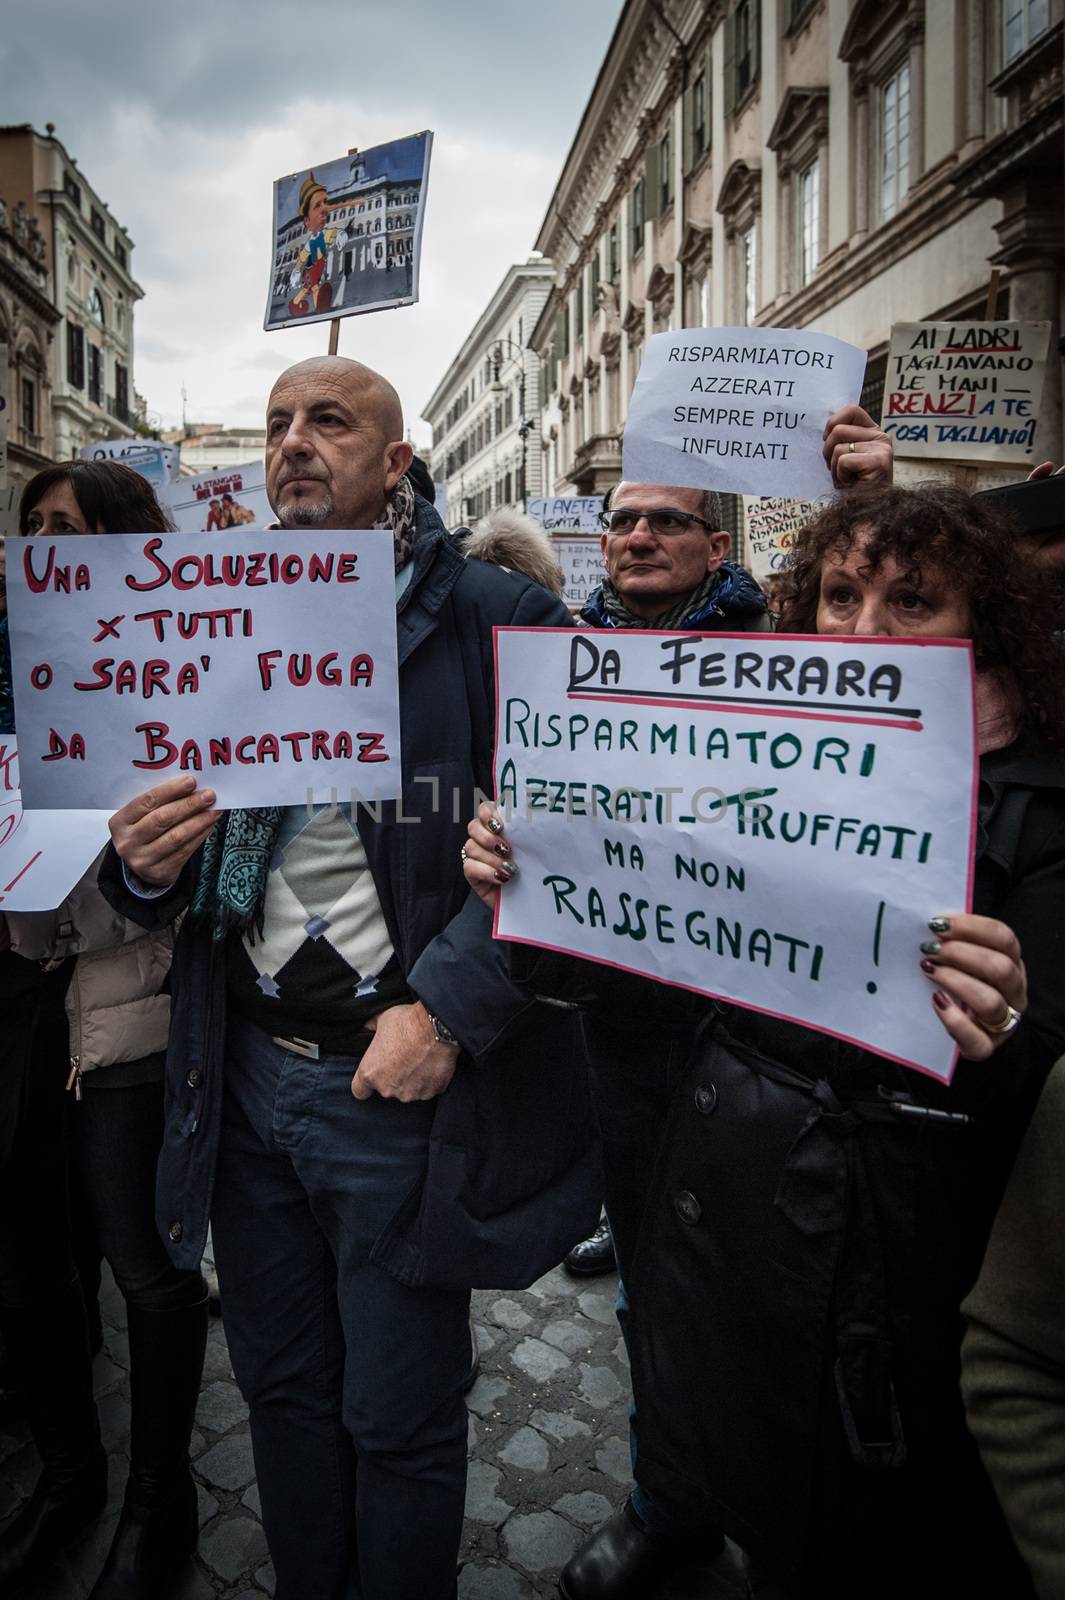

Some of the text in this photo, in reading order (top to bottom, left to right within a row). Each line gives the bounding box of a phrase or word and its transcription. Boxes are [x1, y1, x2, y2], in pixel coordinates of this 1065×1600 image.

[910, 327, 1021, 350] AI LADRI
[668, 346, 835, 370] RISPARMIATORI
[893, 354, 1034, 374] TAGLIAVANO
[690, 377, 795, 397] AZZERATI
[897, 374, 926, 391] LE
[938, 374, 997, 393] MANI
[673, 406, 755, 427] SEMPRE
[888, 392, 1032, 417] RENZI A TE
[681, 437, 789, 461] INFURIATI
[529, 499, 547, 516] CI
[553, 499, 595, 514] AVETE
[24, 538, 361, 594] UNA SOLUZIONE
[571, 574, 586, 584] LA
[134, 608, 254, 643] TUTTI
[73, 655, 211, 699] SARA'
[258, 649, 375, 691] FUGA
[568, 634, 903, 703] DA FERRARA
[41, 721, 391, 772] DA BANCATRAZ
[504, 697, 876, 778] RISPARMIATORI
[499, 757, 664, 825] AZZERATI
[709, 787, 933, 864] TRUFFATI
[603, 838, 746, 892] MA NON
[542, 874, 824, 981] RASSEGNATI
